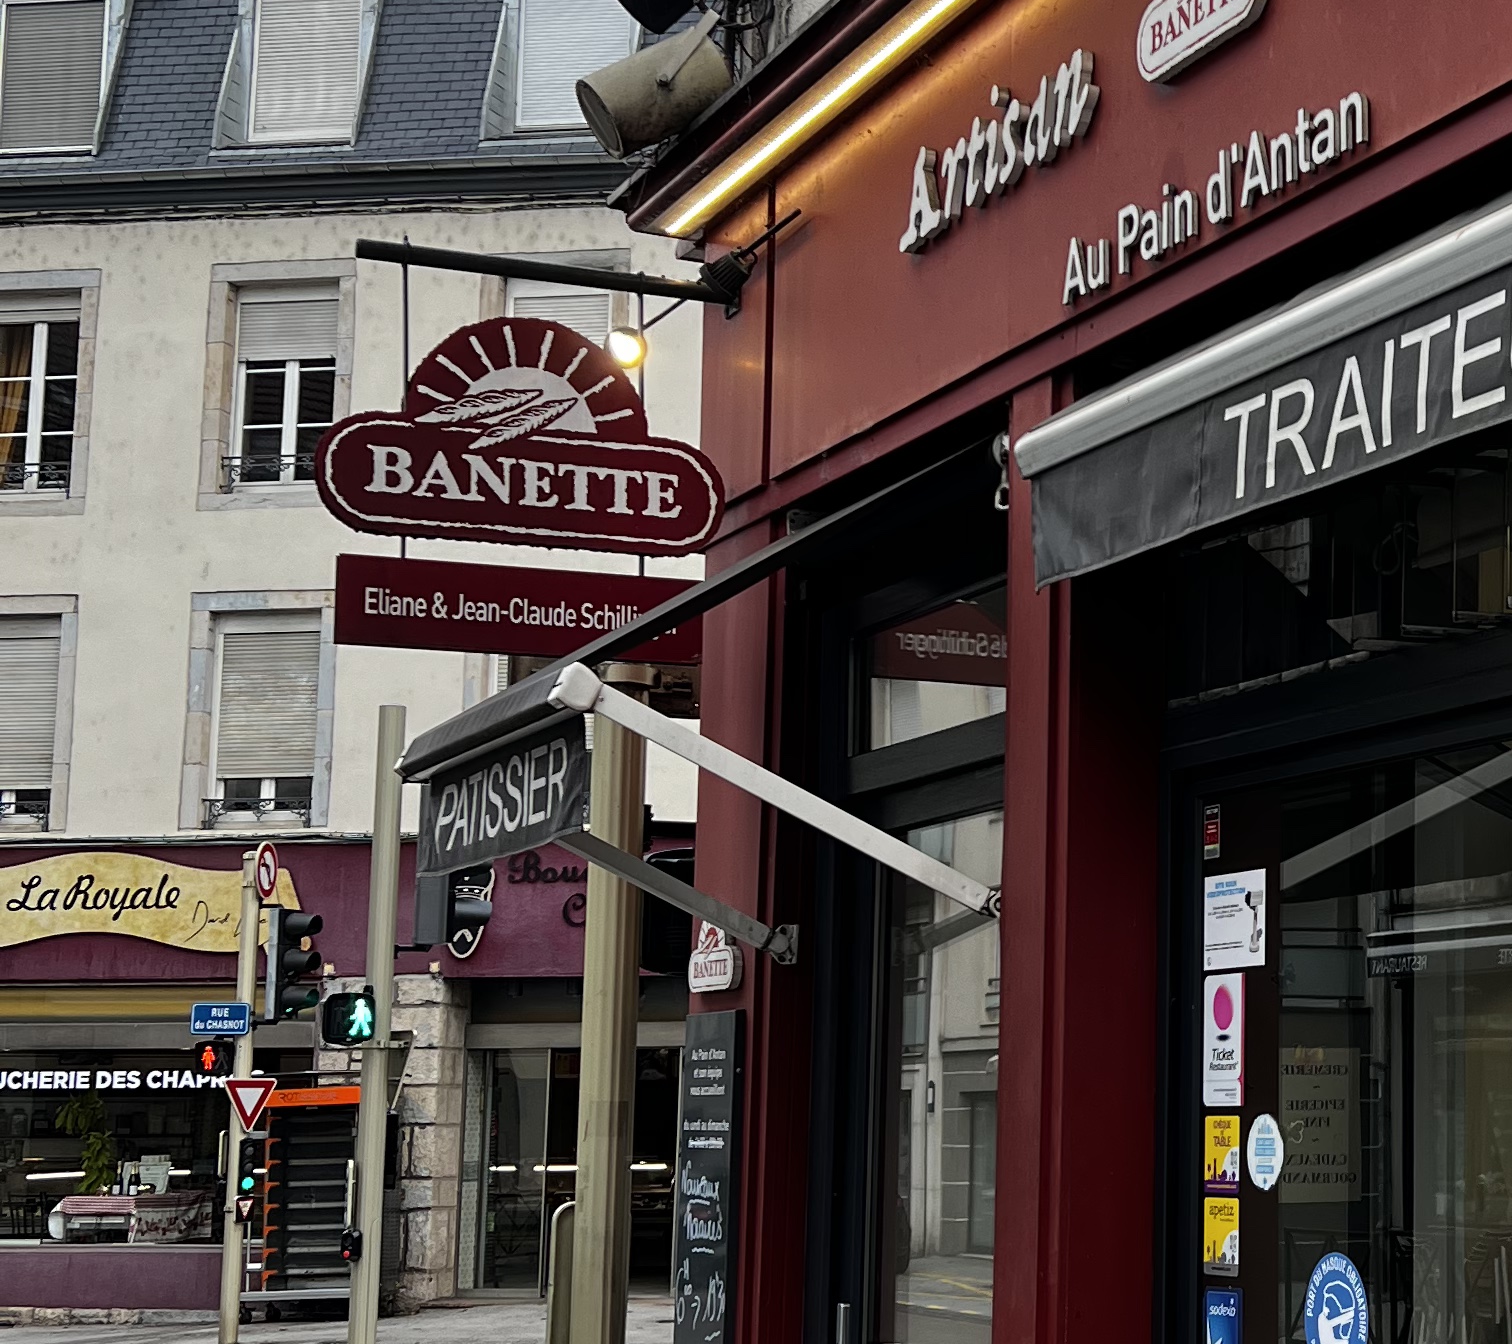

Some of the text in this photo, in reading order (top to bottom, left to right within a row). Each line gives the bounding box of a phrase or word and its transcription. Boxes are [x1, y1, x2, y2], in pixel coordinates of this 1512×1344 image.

[899, 48, 1099, 253] Artisan
[1062, 91, 1370, 305] Au Pain d'Antan
[364, 443, 683, 518] BANETTE
[364, 586, 428, 618] Eliane
[432, 591, 449, 621] &
[452, 594, 578, 628] Jean-Claude
[434, 738, 569, 854] PATISSIER
[7, 873, 181, 922] La Royale
[693, 958, 728, 980] BANETTE
[195, 1020, 205, 1029] du
[211, 1007, 230, 1017] RUE
[1212, 1048, 1235, 1061] Ticket
[96, 1071, 142, 1089] DES
[1306, 1283, 1318, 1317] PORT
